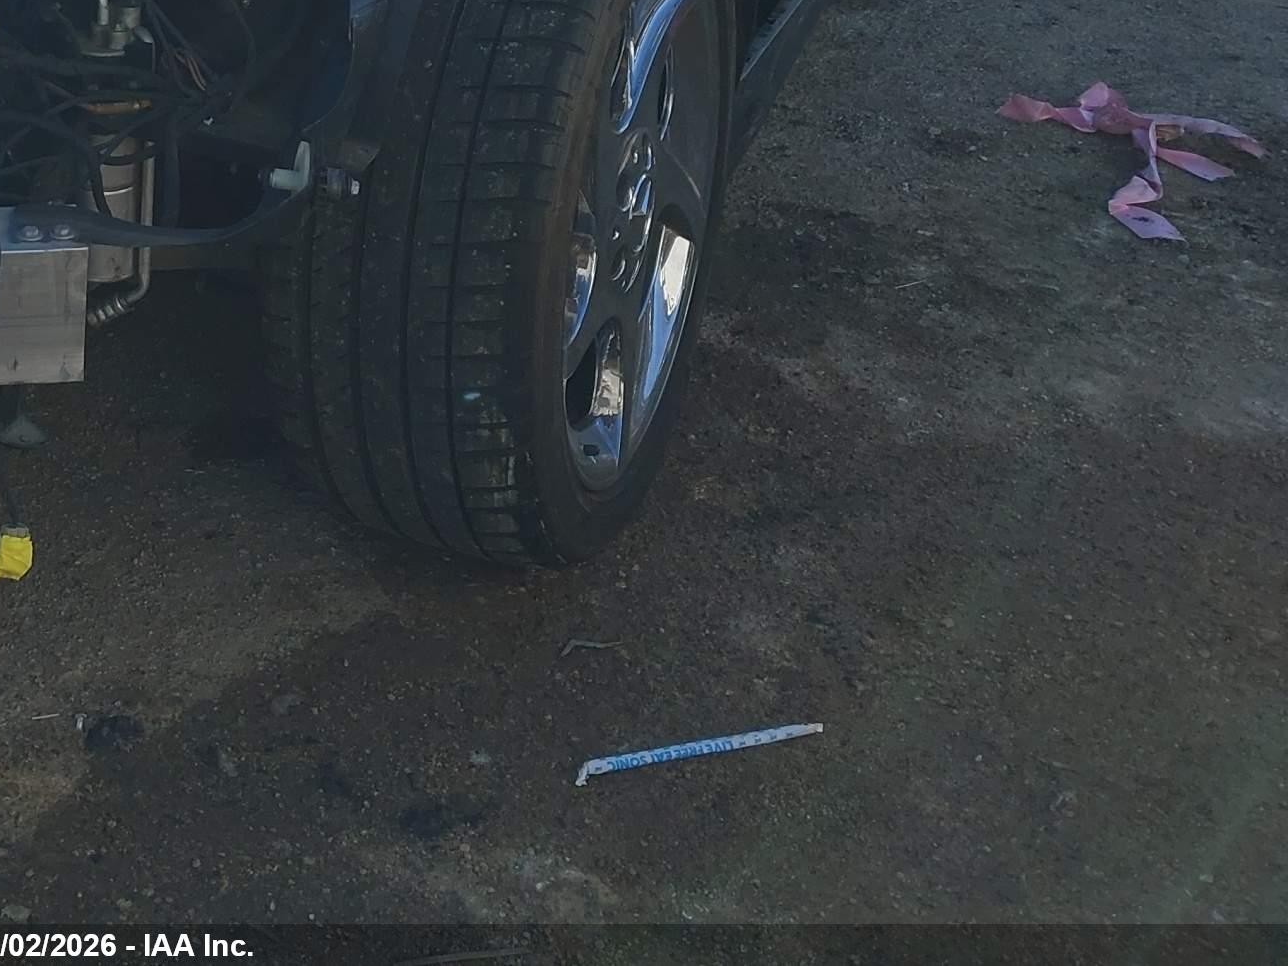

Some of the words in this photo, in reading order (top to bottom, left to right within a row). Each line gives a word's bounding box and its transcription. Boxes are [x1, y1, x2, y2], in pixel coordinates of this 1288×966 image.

[673, 745, 705, 758] FREE
[707, 740, 734, 752] LIVE
[607, 755, 648, 771] SONIC
